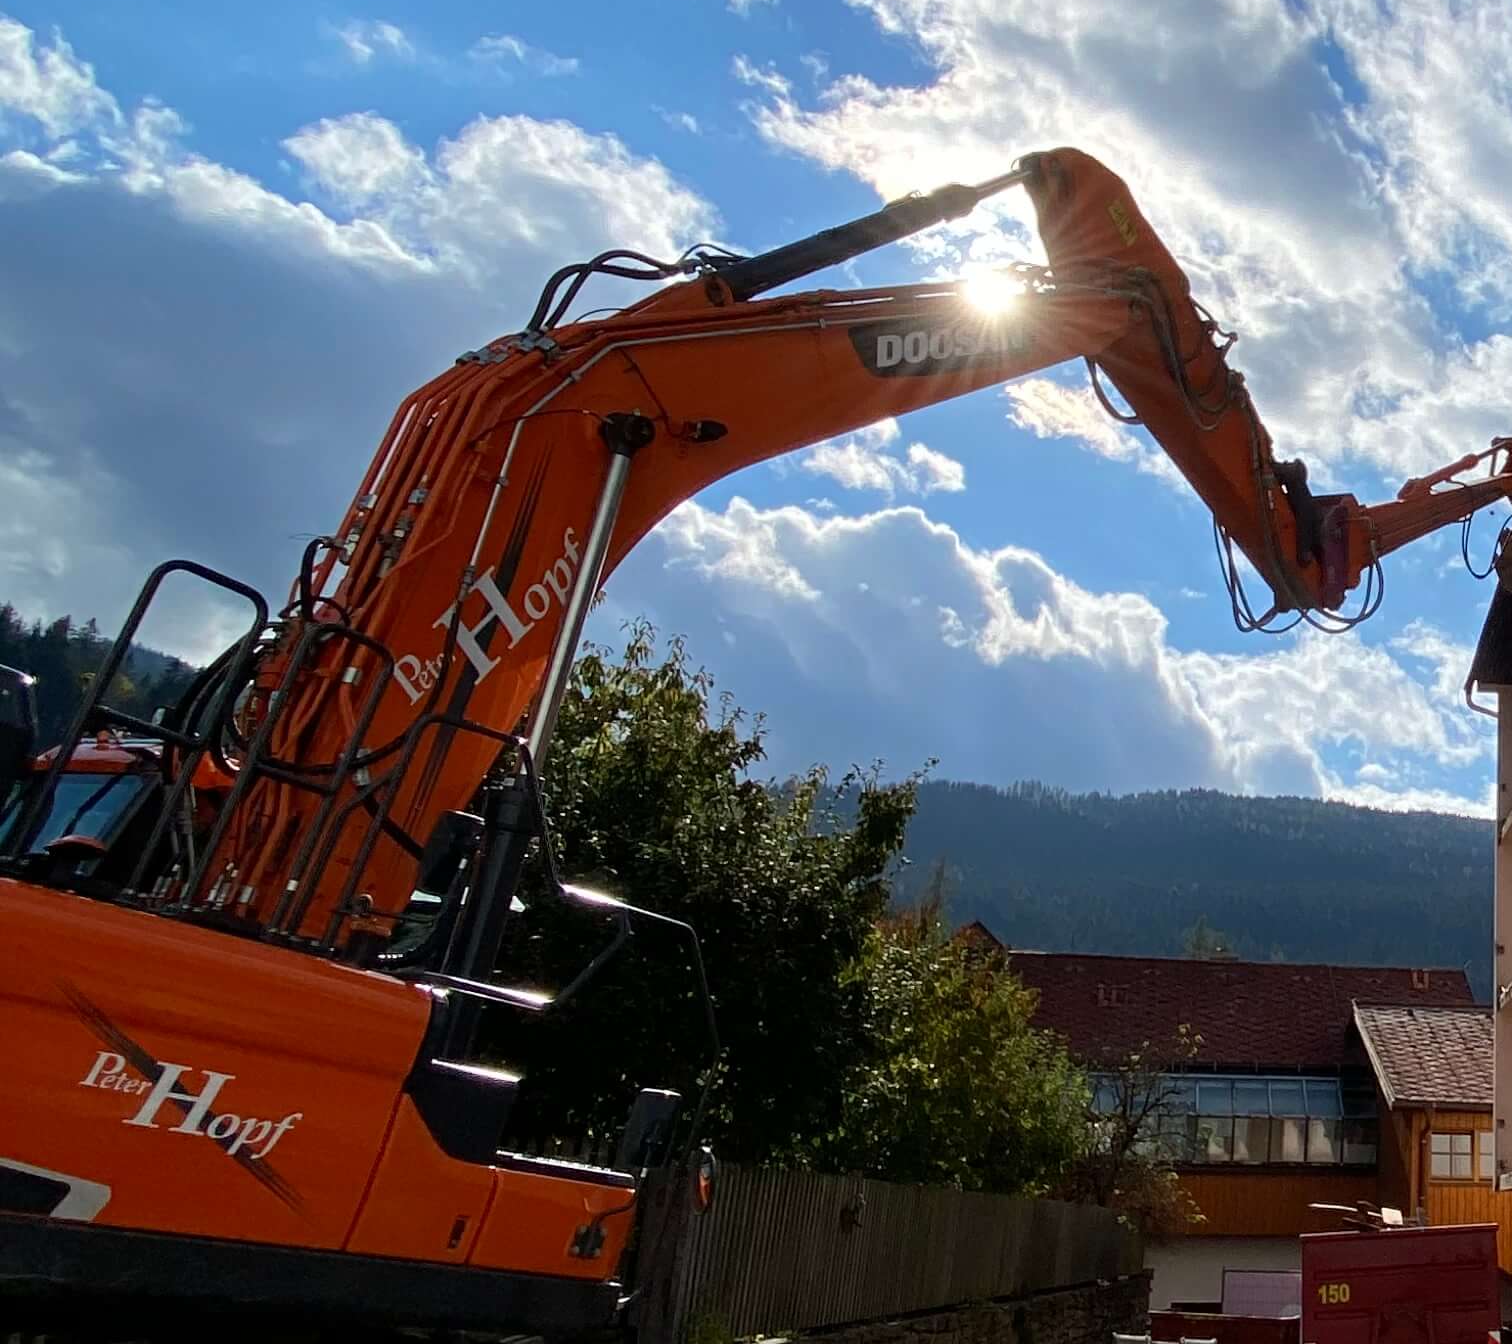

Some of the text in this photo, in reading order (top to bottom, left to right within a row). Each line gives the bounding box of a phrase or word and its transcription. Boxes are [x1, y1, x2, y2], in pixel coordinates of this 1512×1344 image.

[393, 526, 580, 707] Pet Hopf
[78, 1050, 304, 1160] Peter Hopf
[1318, 1283, 1350, 1305] 150
